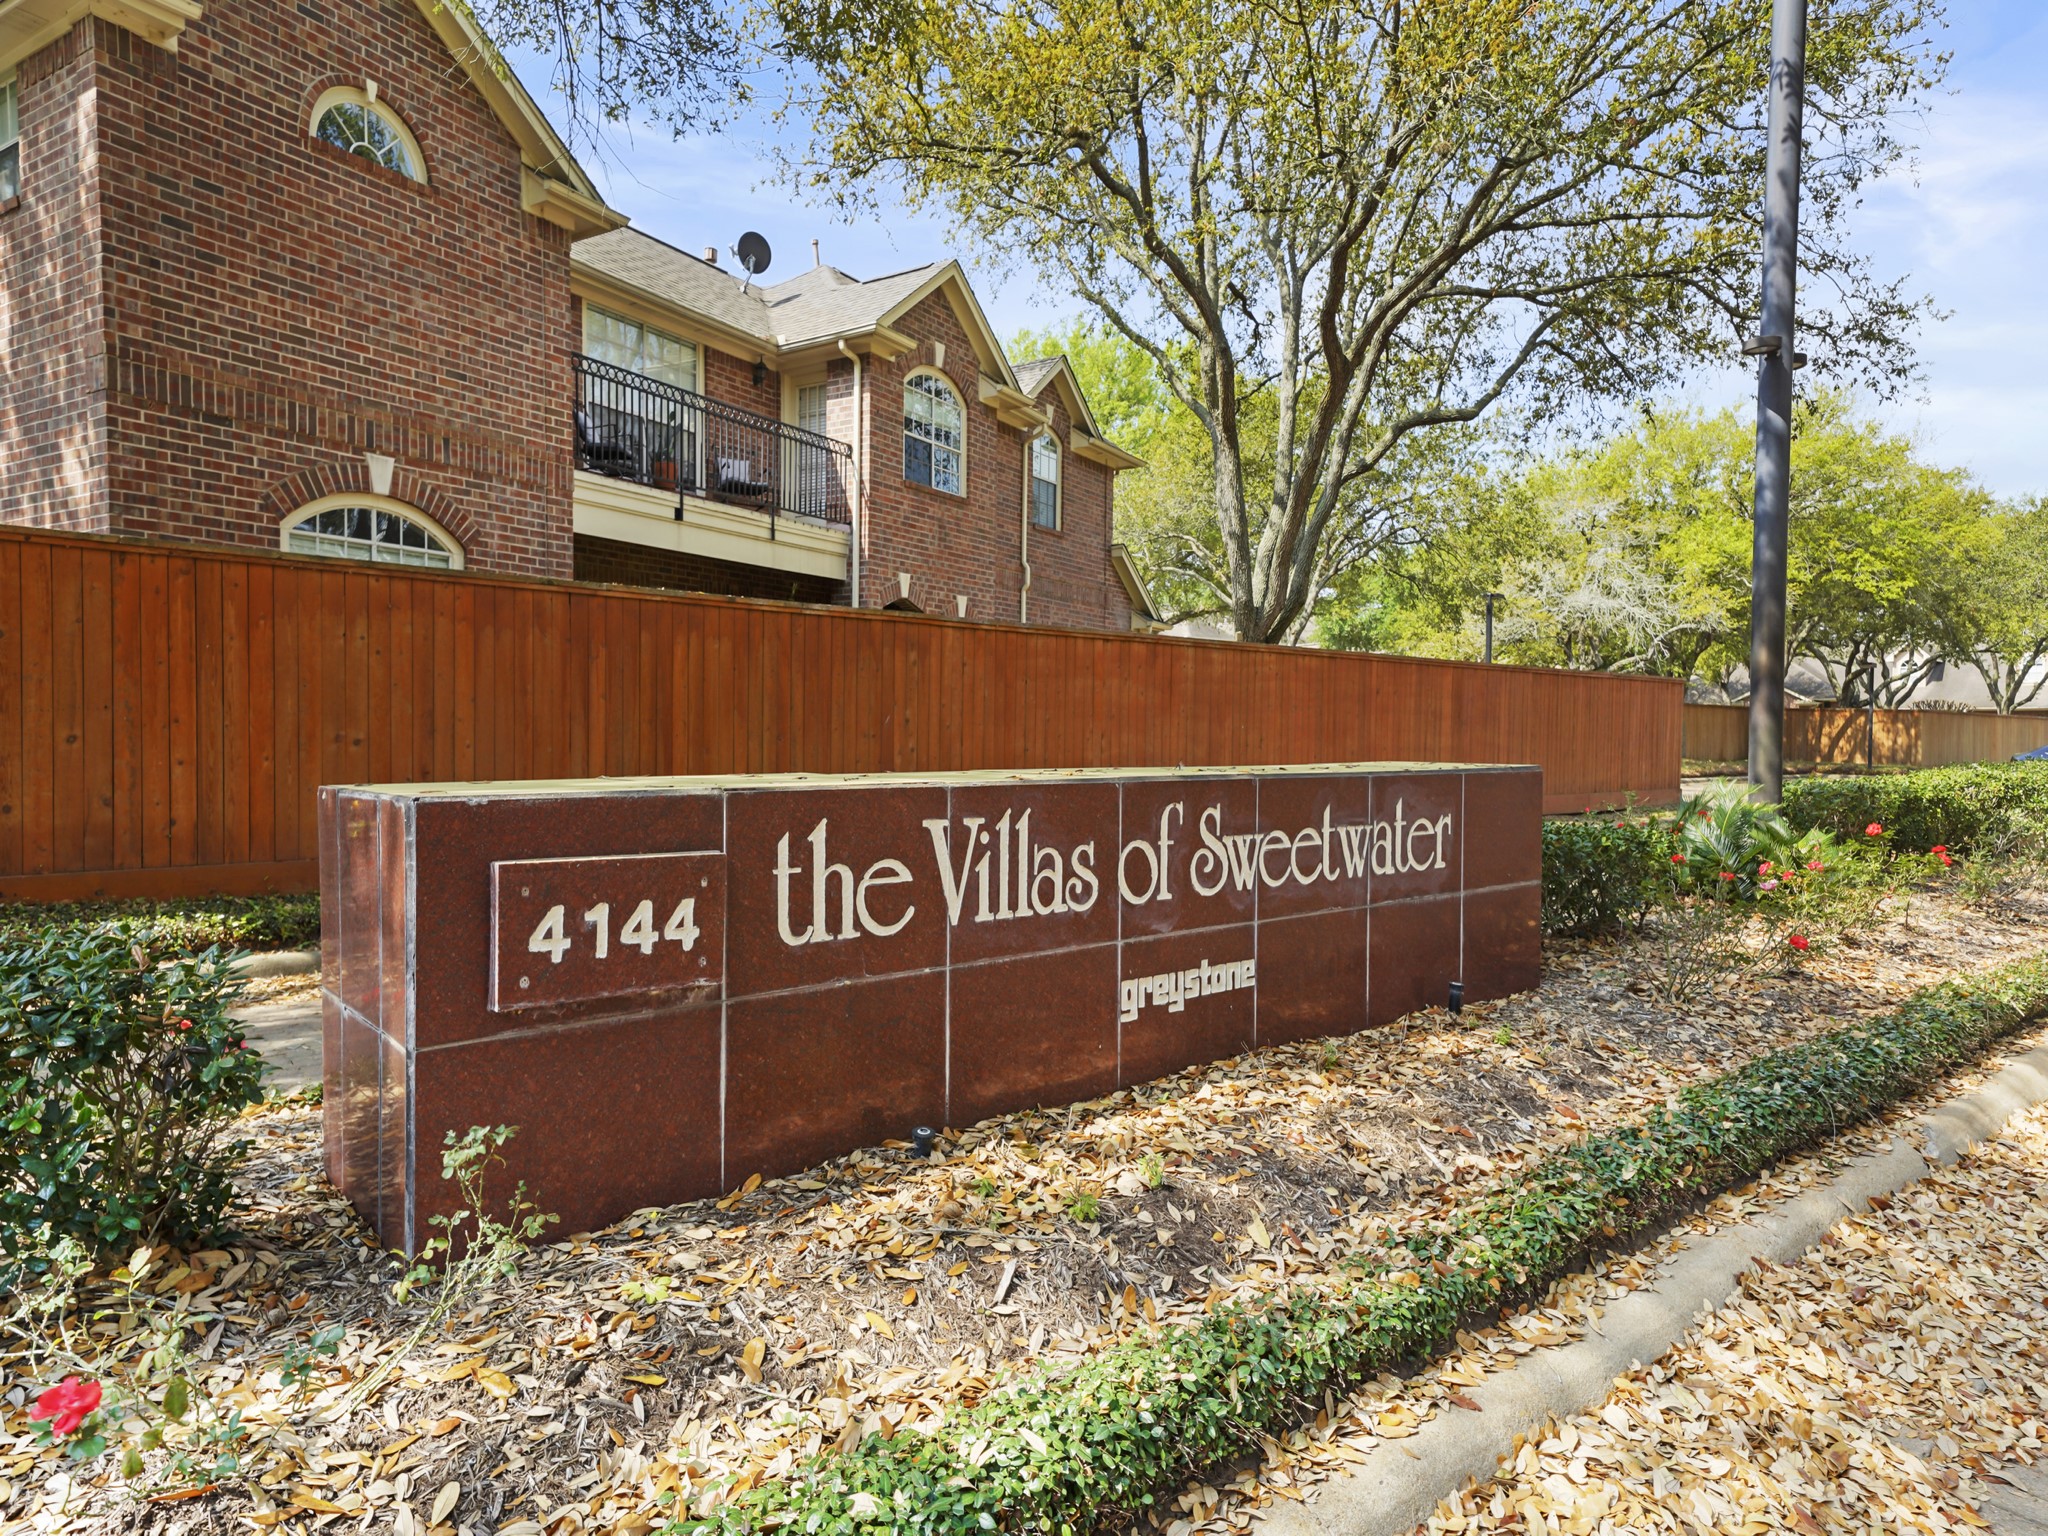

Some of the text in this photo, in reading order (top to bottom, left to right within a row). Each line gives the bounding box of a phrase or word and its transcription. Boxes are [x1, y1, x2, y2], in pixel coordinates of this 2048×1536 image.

[773, 798, 1453, 947] the Villas of Sweetwater
[527, 898, 700, 963] 4144
[1120, 958, 1257, 1023] greystone
